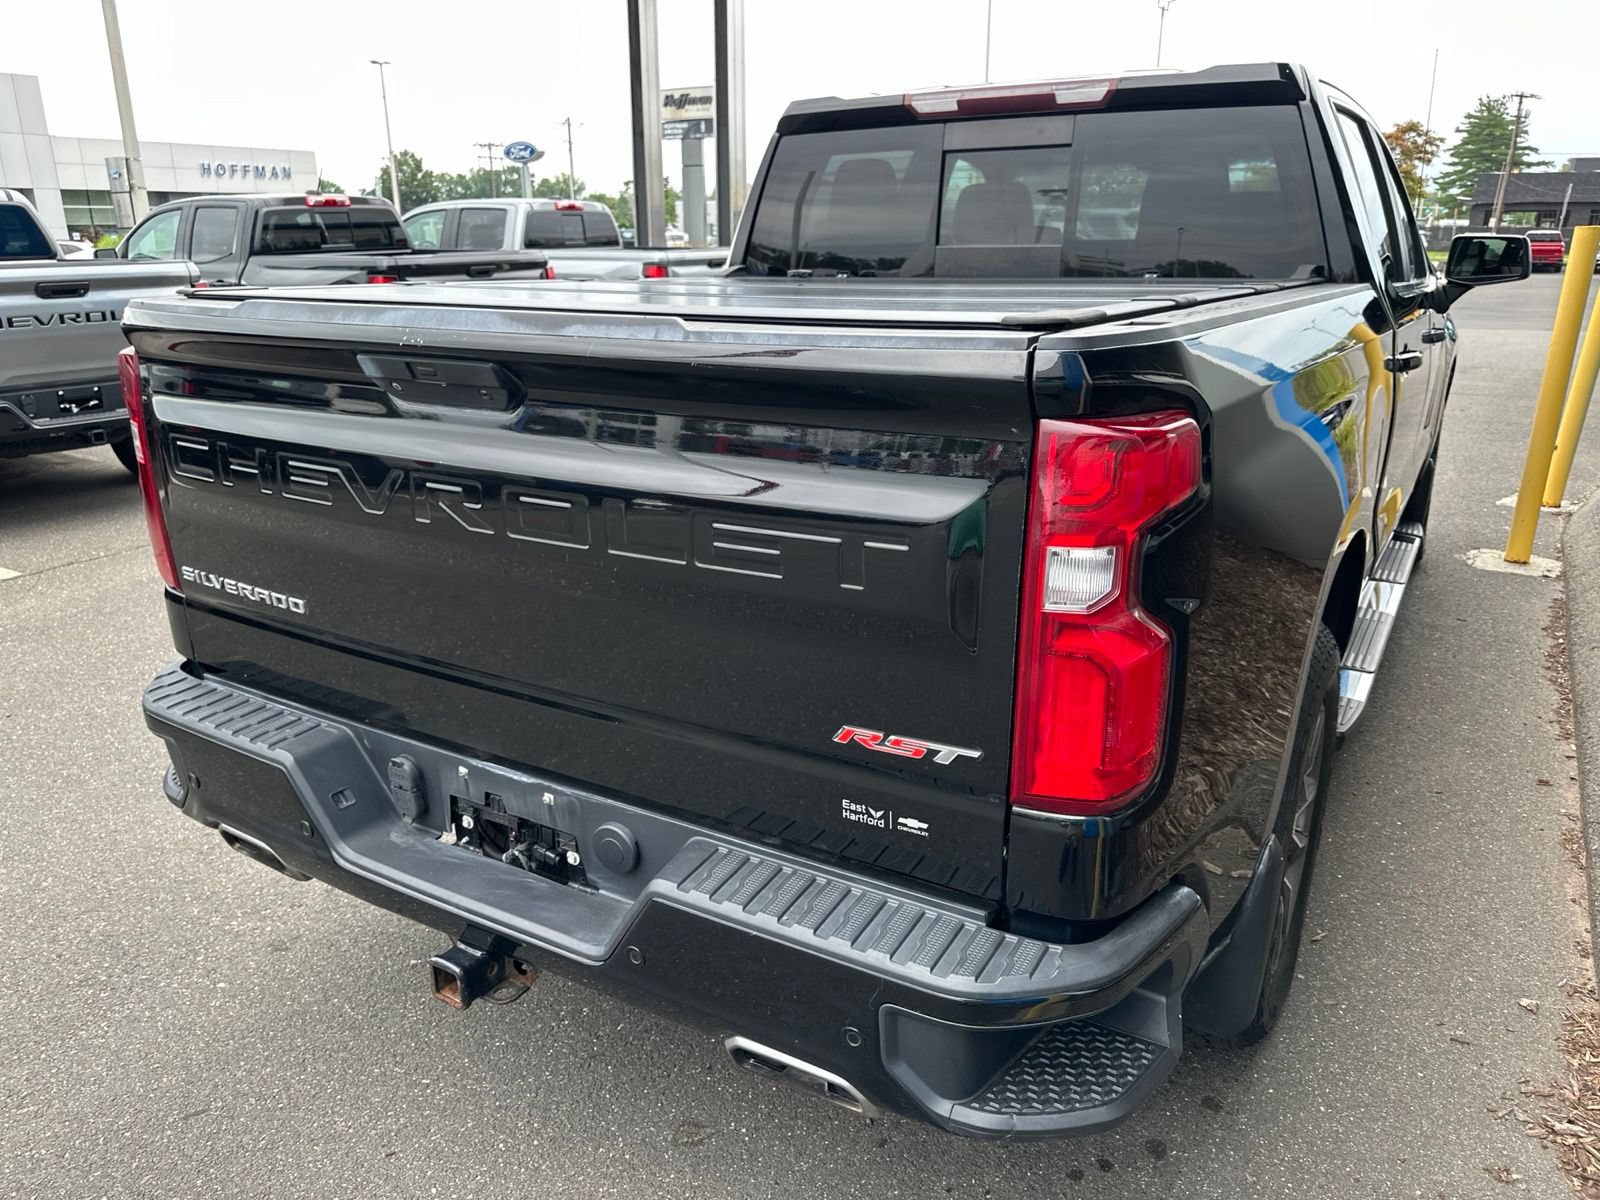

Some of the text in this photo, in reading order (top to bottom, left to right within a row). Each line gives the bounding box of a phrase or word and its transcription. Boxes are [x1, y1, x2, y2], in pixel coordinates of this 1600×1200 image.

[663, 93, 713, 110] Hoffman
[510, 145, 532, 159] Ford
[200, 162, 293, 180] HOFFMAN
[168, 432, 910, 592] CHEVROLET
[181, 565, 306, 614] SILVERADO
[832, 725, 984, 765] RST
[842, 799, 867, 813] East
[842, 809, 885, 828] Hartford
[897, 825, 930, 838] CHEVROLET
